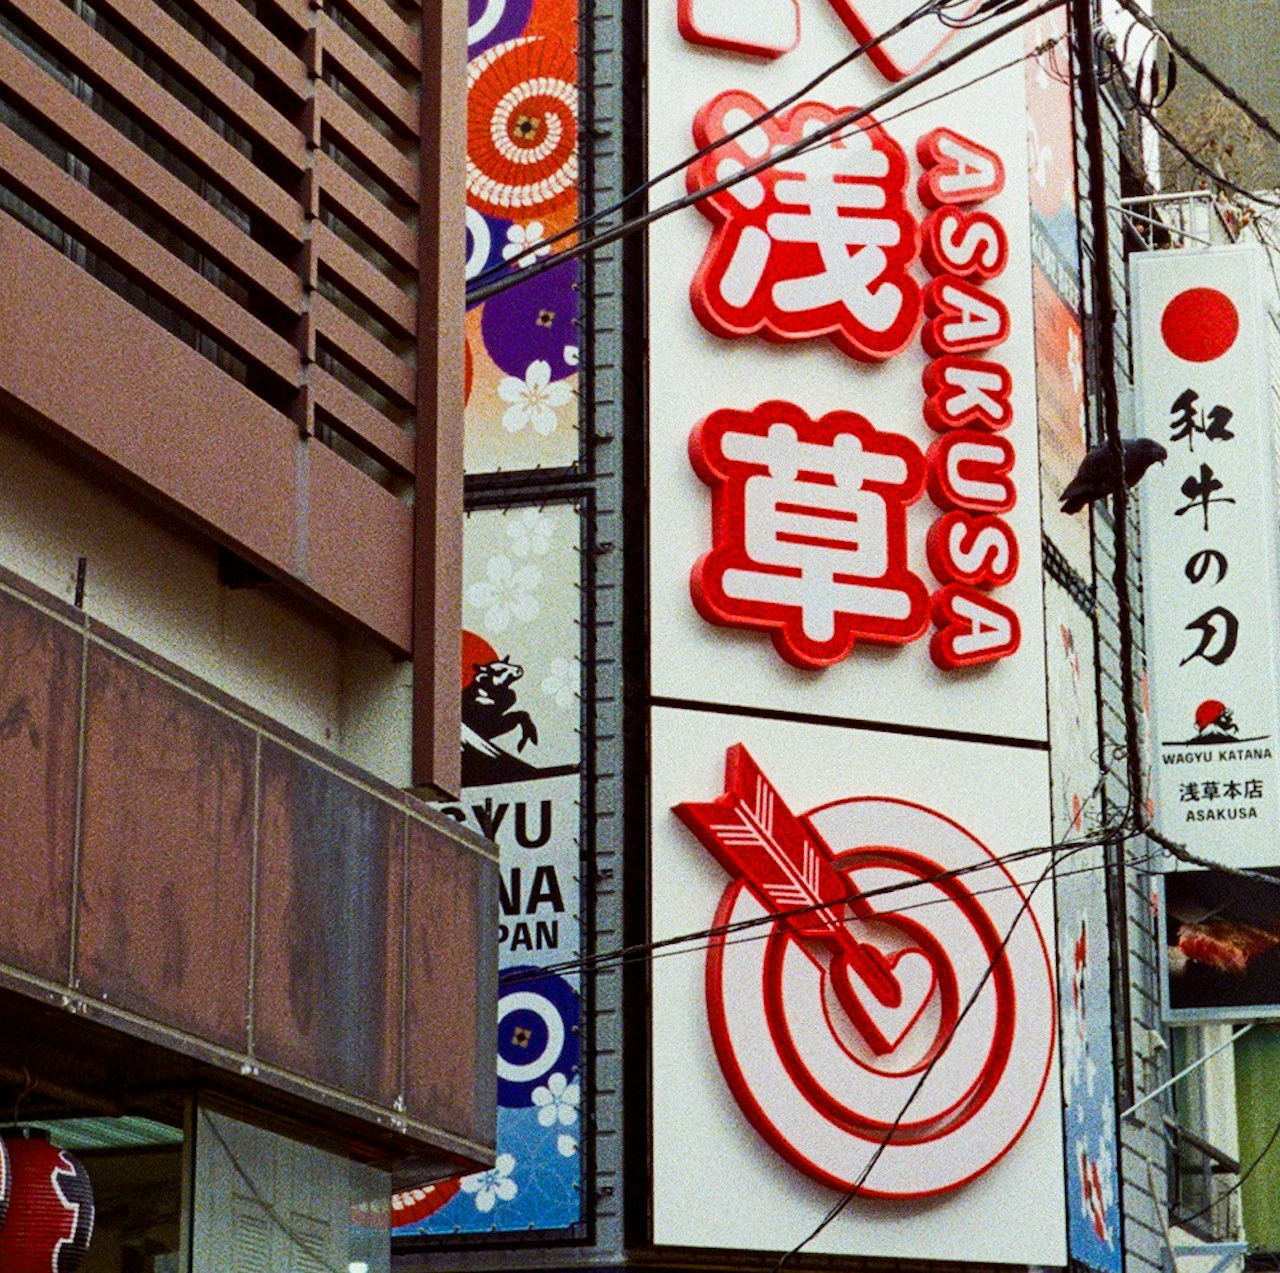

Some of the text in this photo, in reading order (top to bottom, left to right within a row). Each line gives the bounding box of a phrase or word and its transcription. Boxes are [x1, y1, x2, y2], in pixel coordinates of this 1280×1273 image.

[692, 91, 929, 670] 浅草
[922, 129, 1020, 668] ASAKUSA
[1168, 387, 1240, 668] 和牛の刀
[1161, 747, 1273, 766] WAGYU KATANA
[1178, 778, 1264, 803] 浅草本店
[1185, 806, 1259, 823] ASAKUSA
